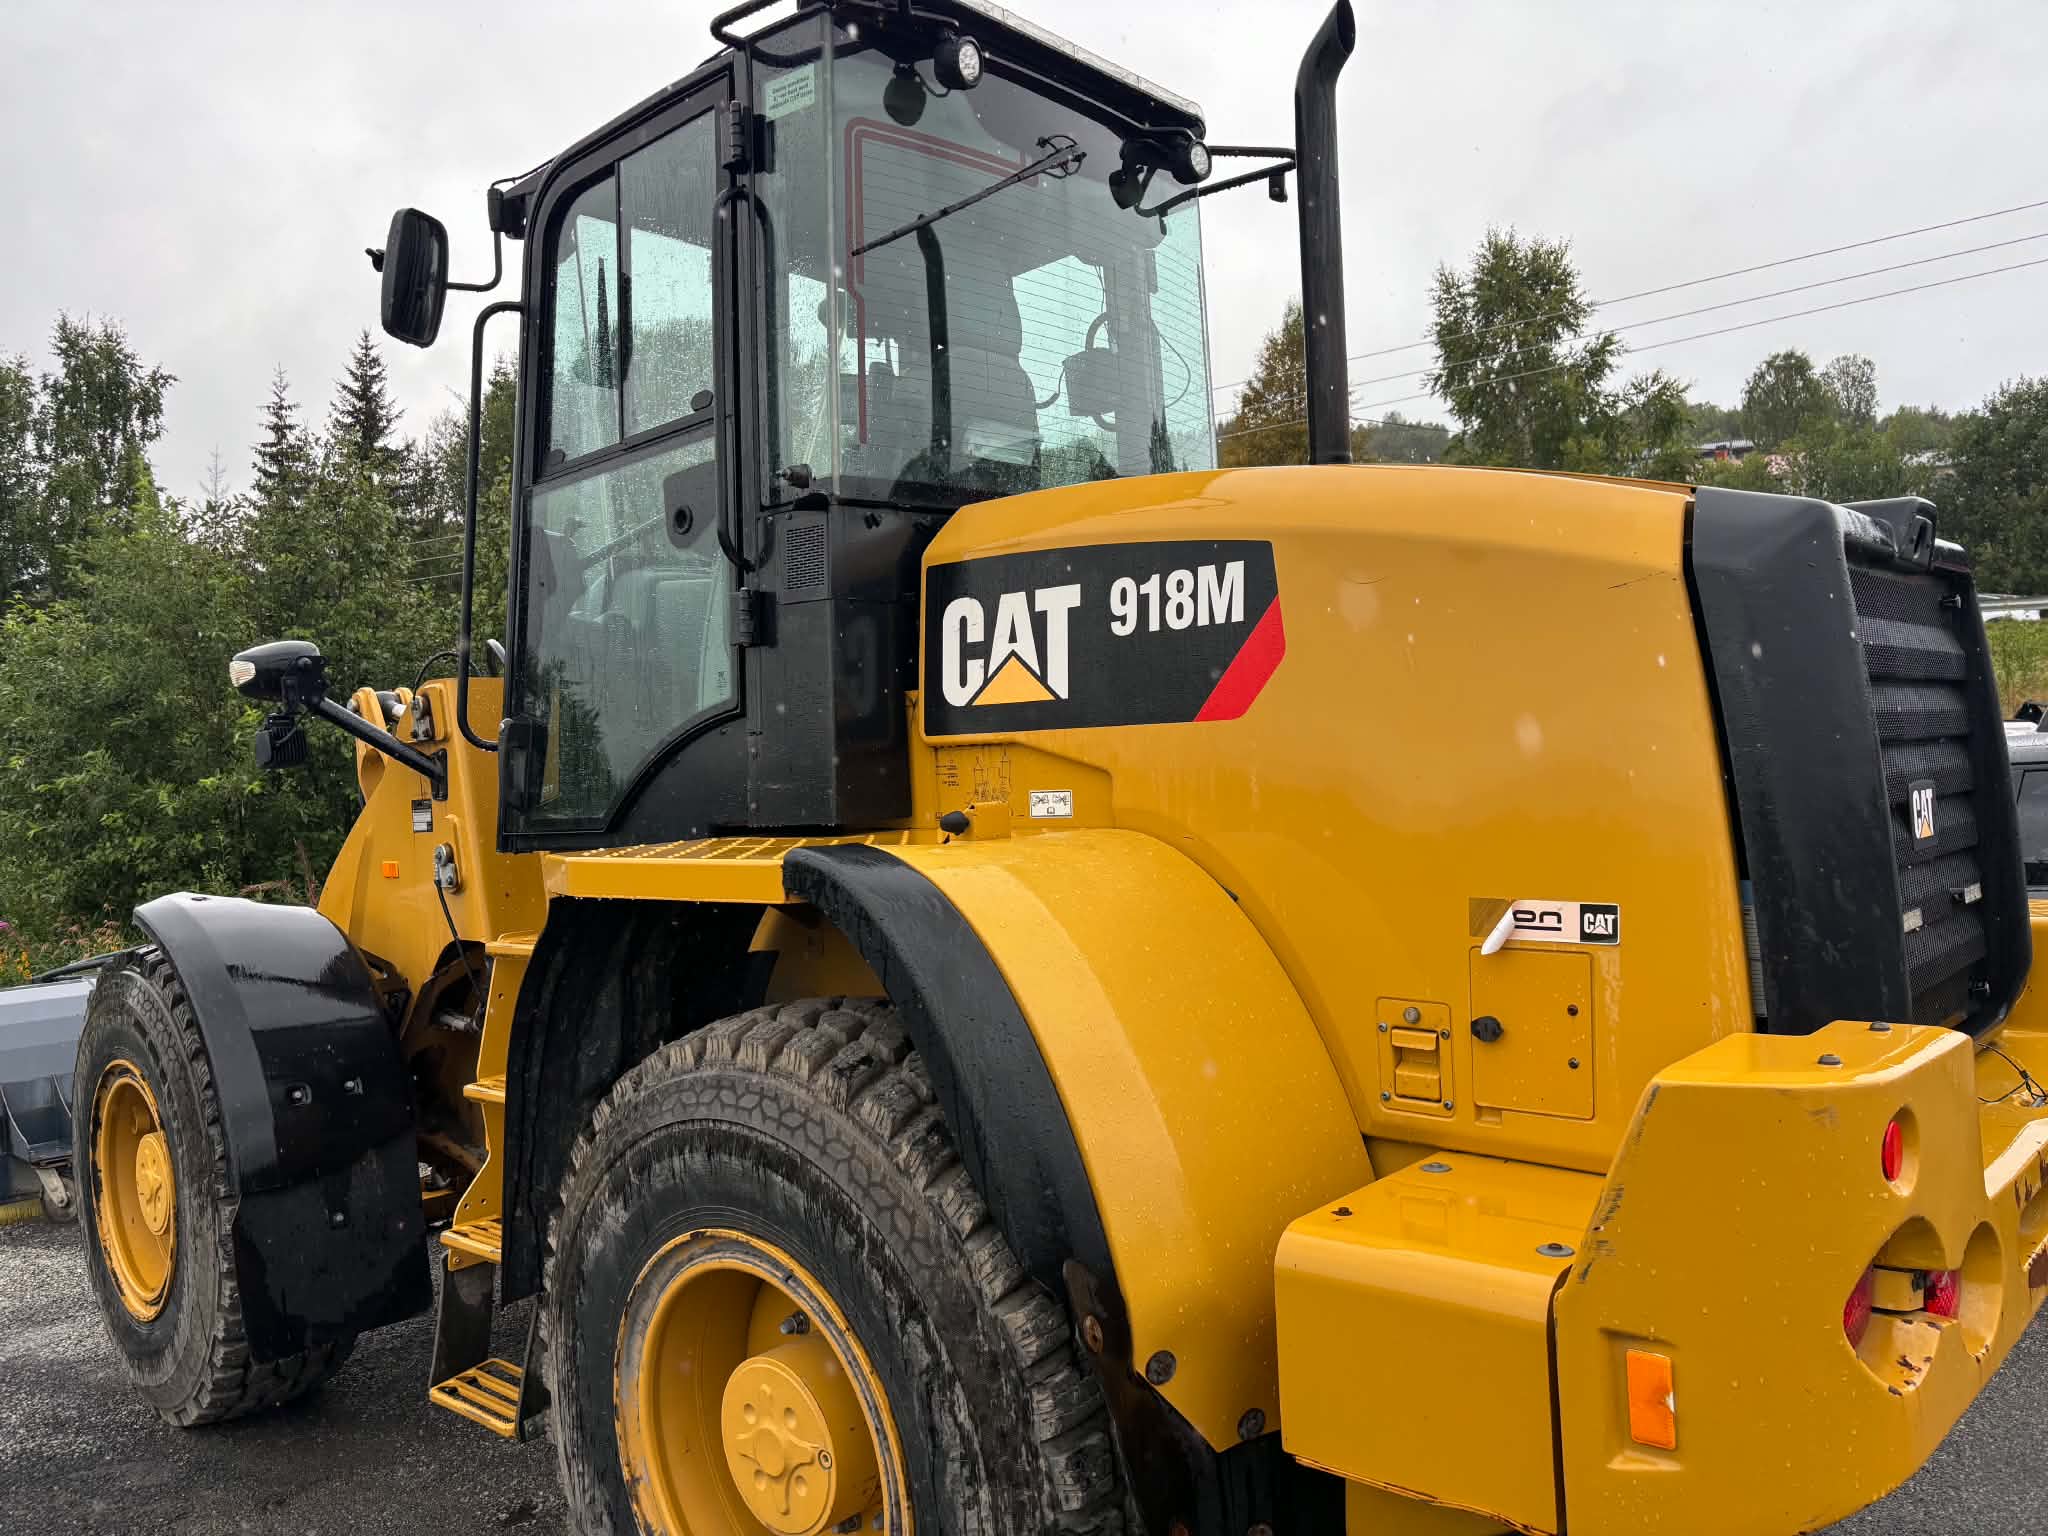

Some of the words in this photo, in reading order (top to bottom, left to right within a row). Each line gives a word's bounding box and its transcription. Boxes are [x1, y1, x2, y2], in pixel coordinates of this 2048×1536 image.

[943, 584, 1081, 707] CAT
[1110, 561, 1245, 637] 918M
[1913, 788, 1934, 839] CAT
[1512, 909, 1562, 926] on
[1583, 913, 1617, 935] CAT
